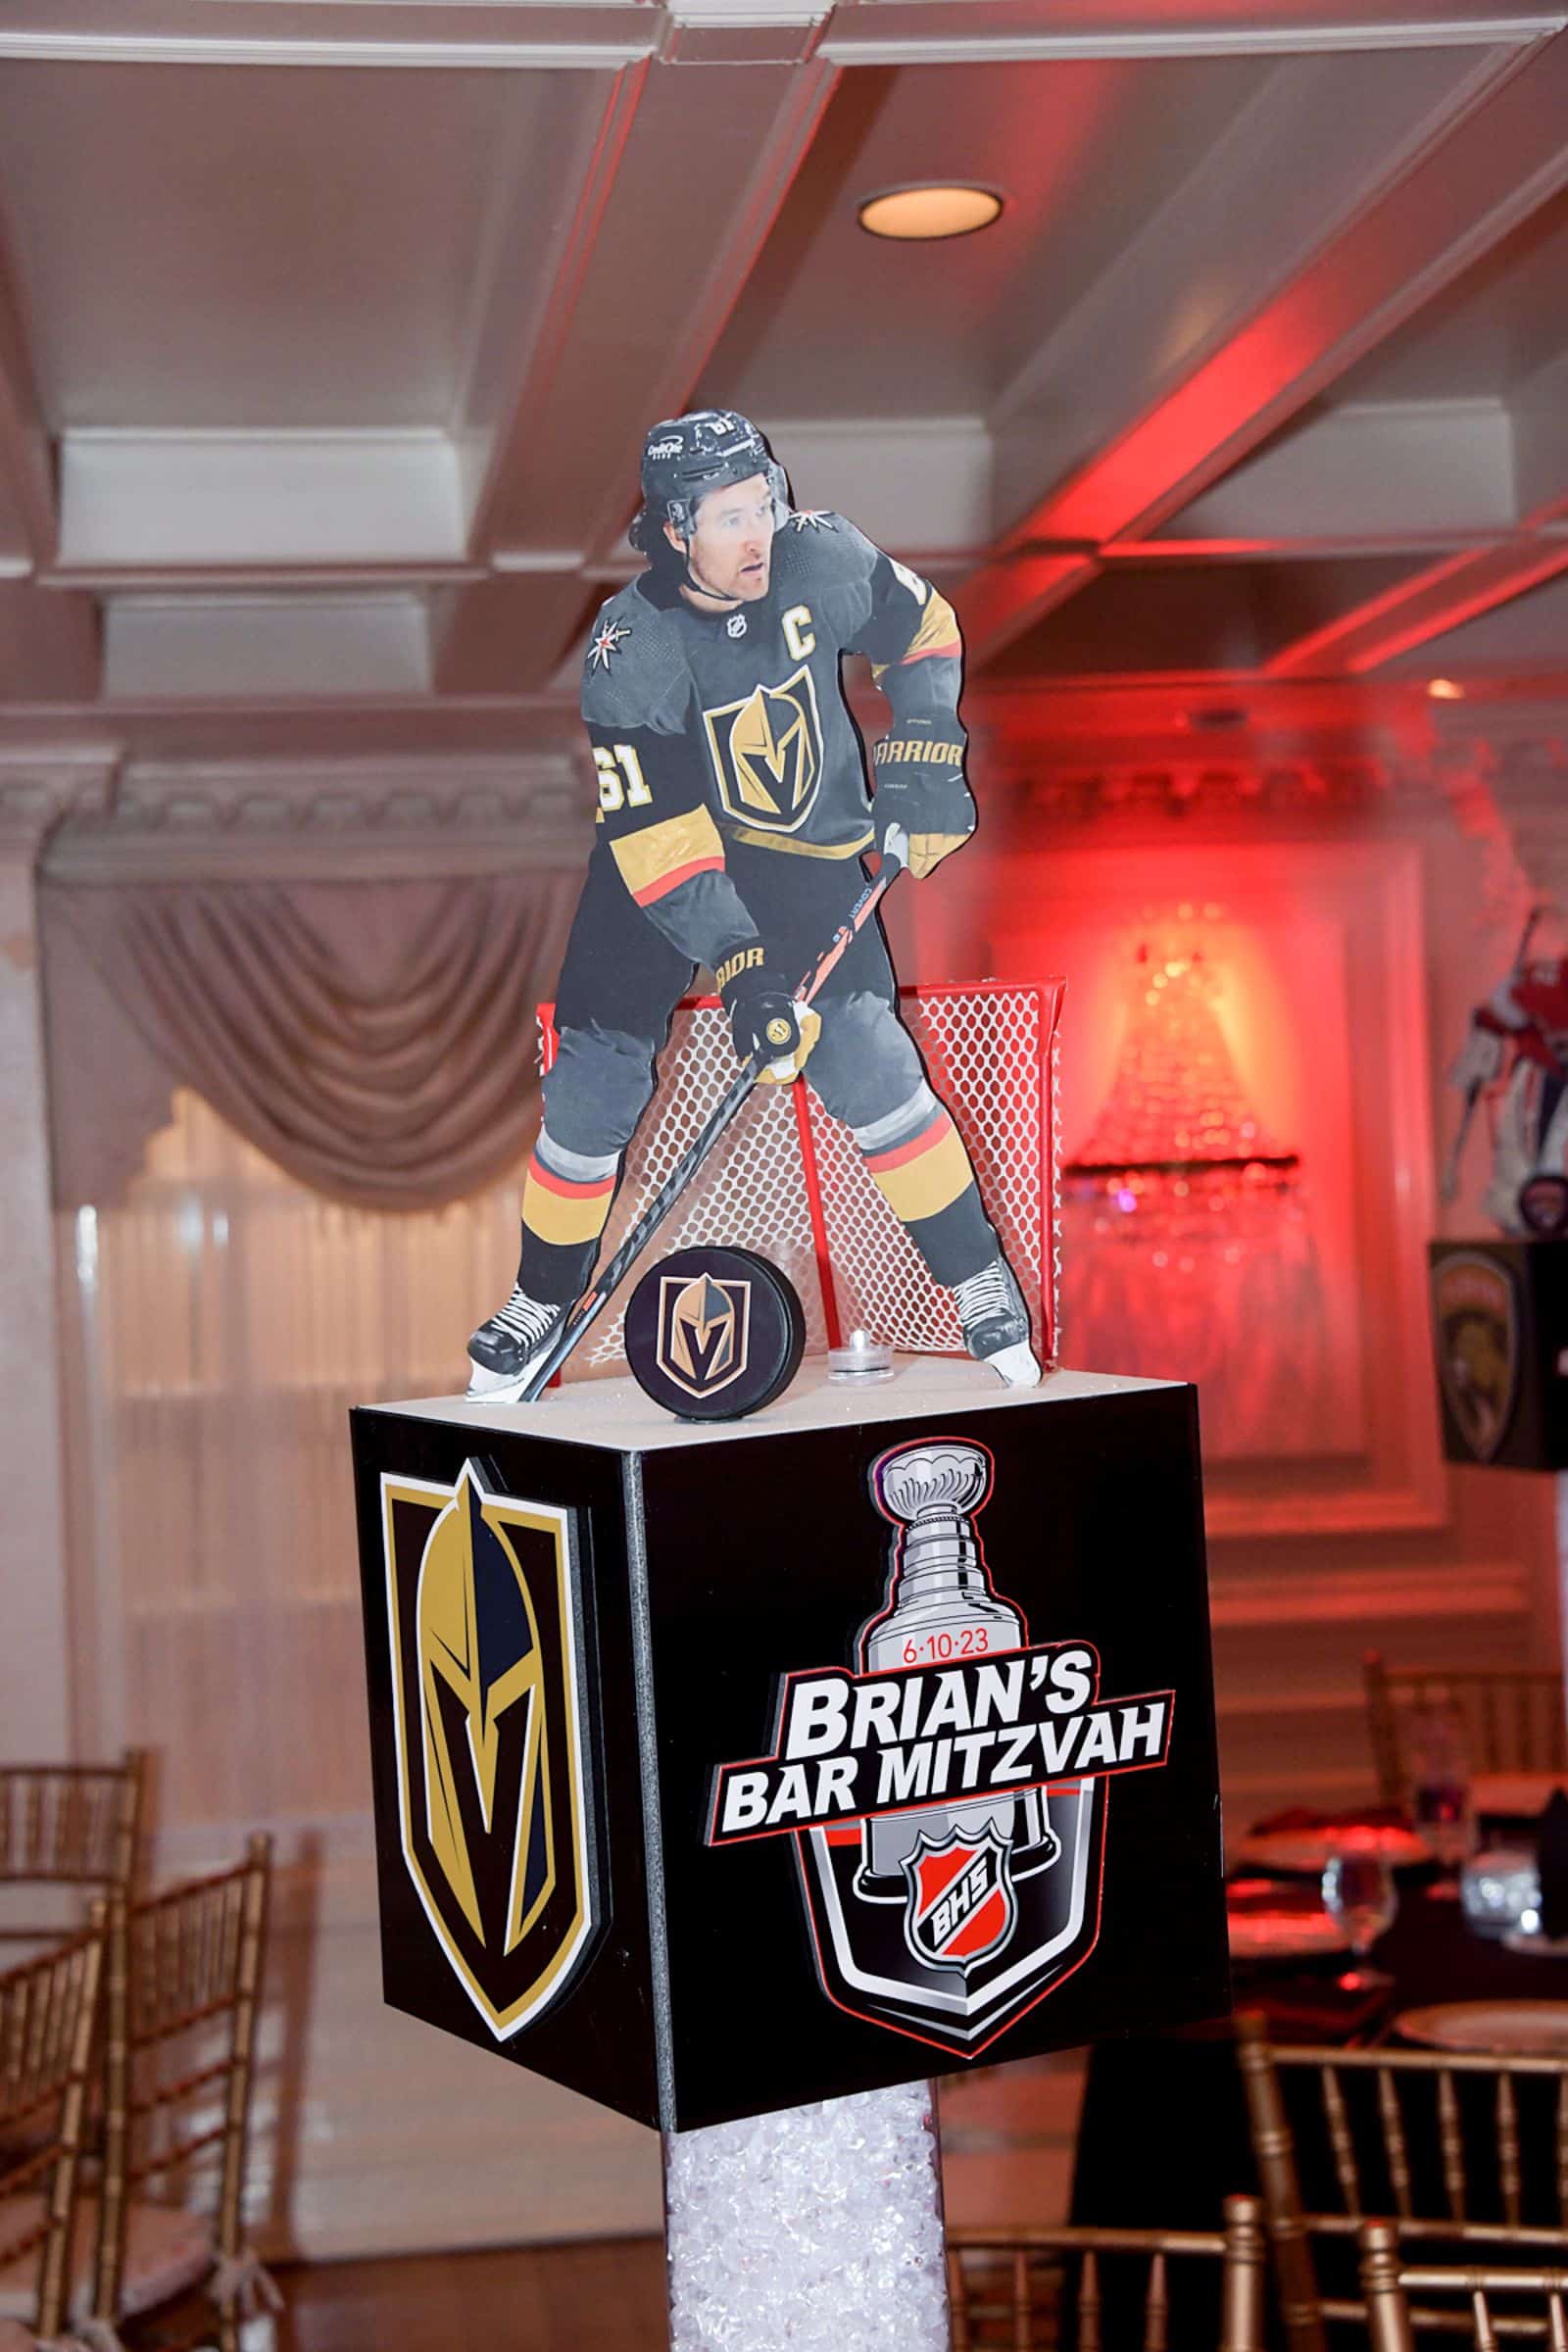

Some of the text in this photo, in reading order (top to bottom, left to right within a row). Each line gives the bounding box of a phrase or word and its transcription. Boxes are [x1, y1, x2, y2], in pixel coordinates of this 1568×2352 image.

[781, 605, 815, 662] C
[592, 745, 653, 811] 61
[873, 740, 963, 766] ARRIOR
[785, 1649, 1092, 1760] BRIAN'S
[722, 1702, 1165, 1833] BAR MITZVAH
[930, 1856, 990, 1947] BHS
